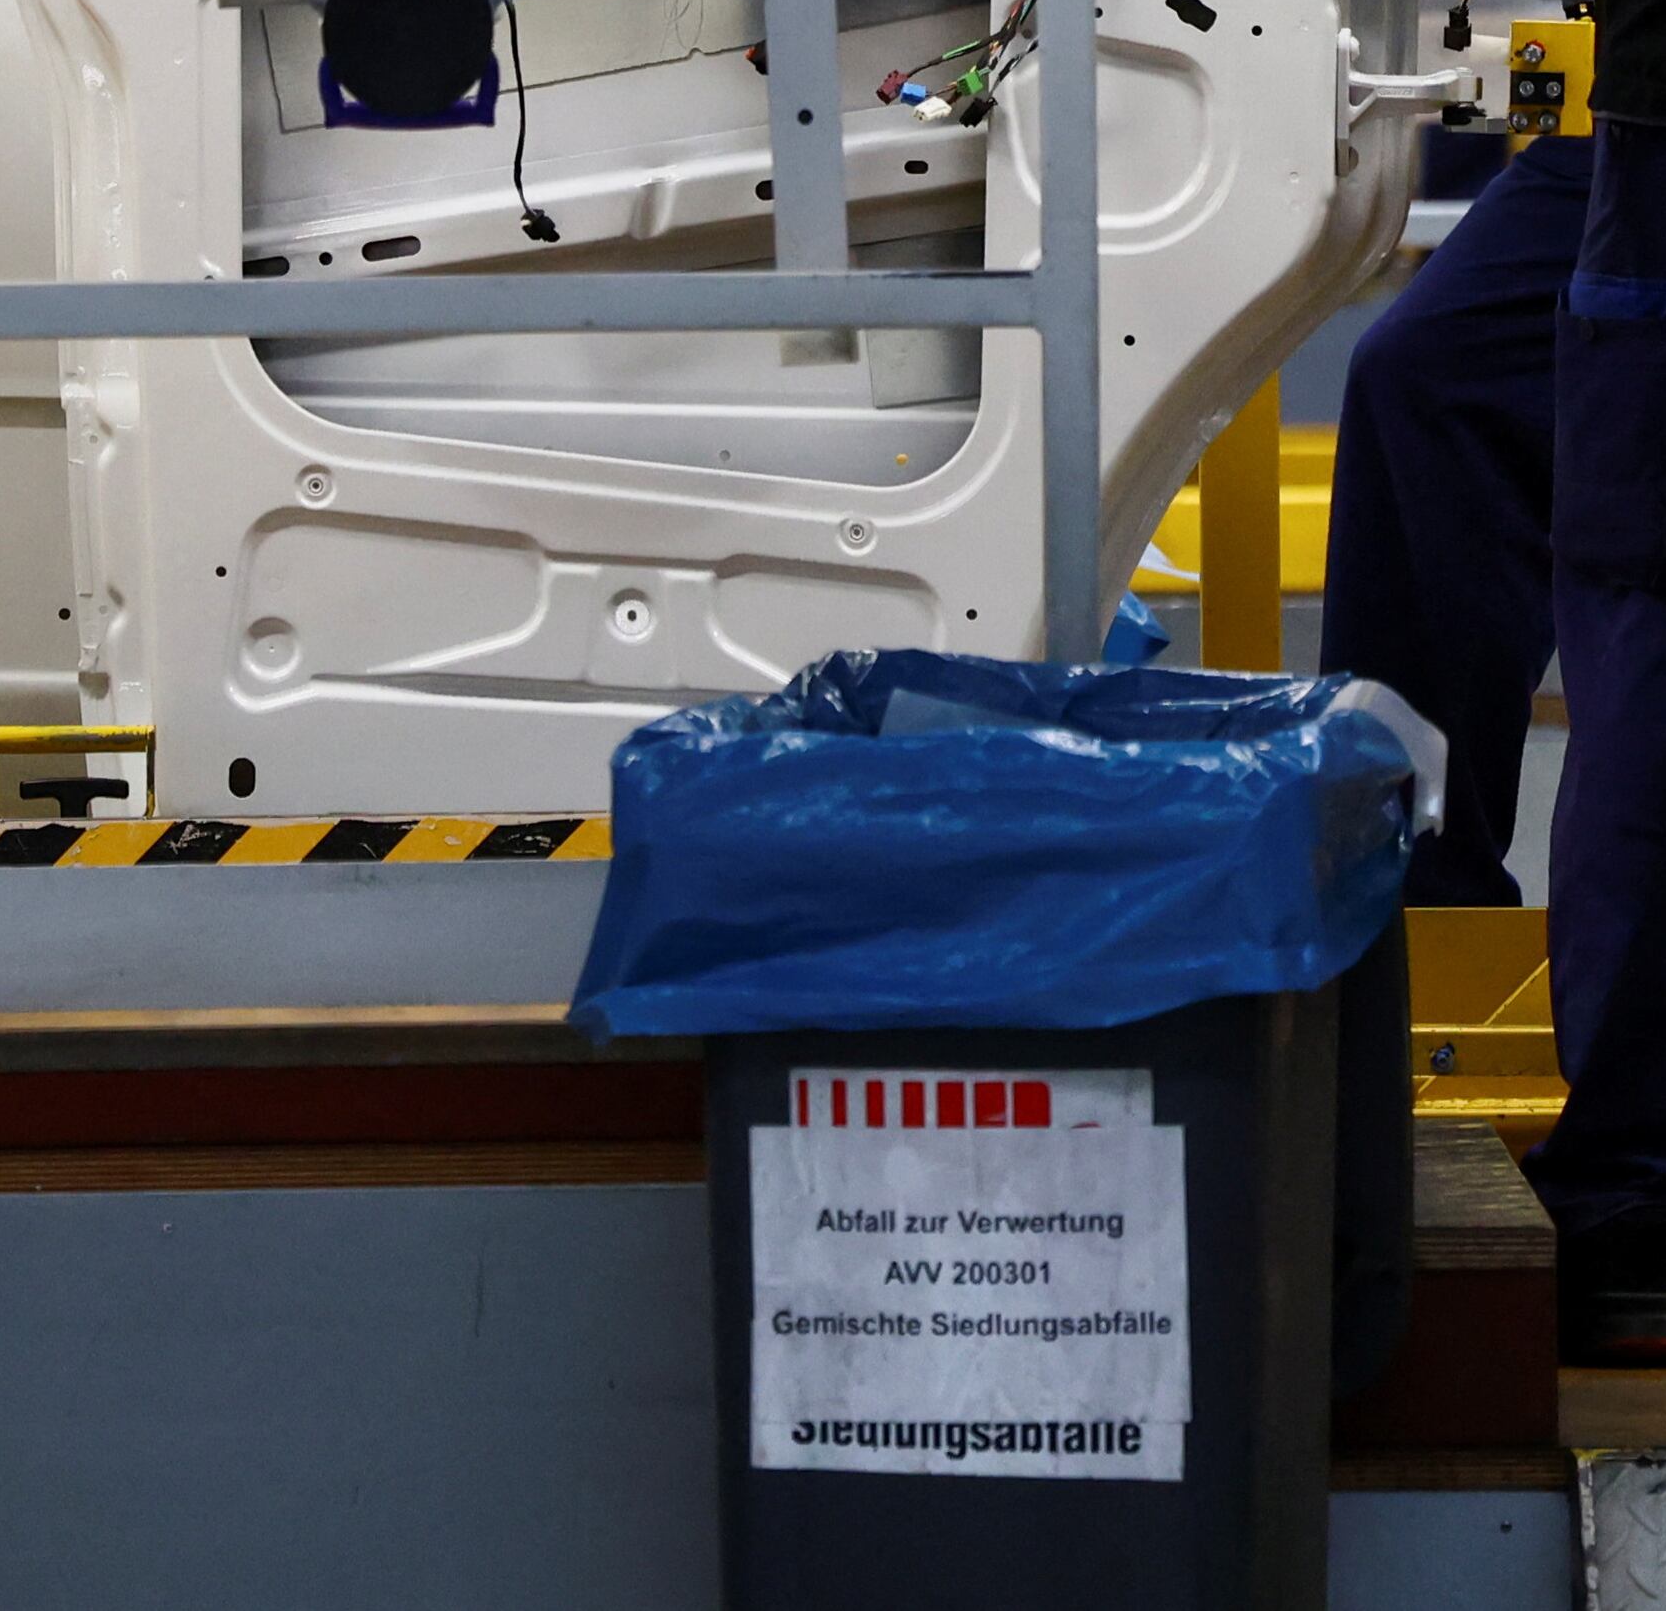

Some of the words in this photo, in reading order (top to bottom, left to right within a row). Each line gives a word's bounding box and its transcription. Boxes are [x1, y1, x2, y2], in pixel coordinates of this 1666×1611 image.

[816, 1209, 895, 1233] Abfall
[904, 1215, 948, 1233] zur
[957, 1210, 1125, 1238] Verwertung
[884, 1261, 942, 1285] AVV
[952, 1261, 1051, 1285] 200301
[772, 1311, 922, 1336] Gemischte
[930, 1311, 1172, 1341] Siedlungsabfälle
